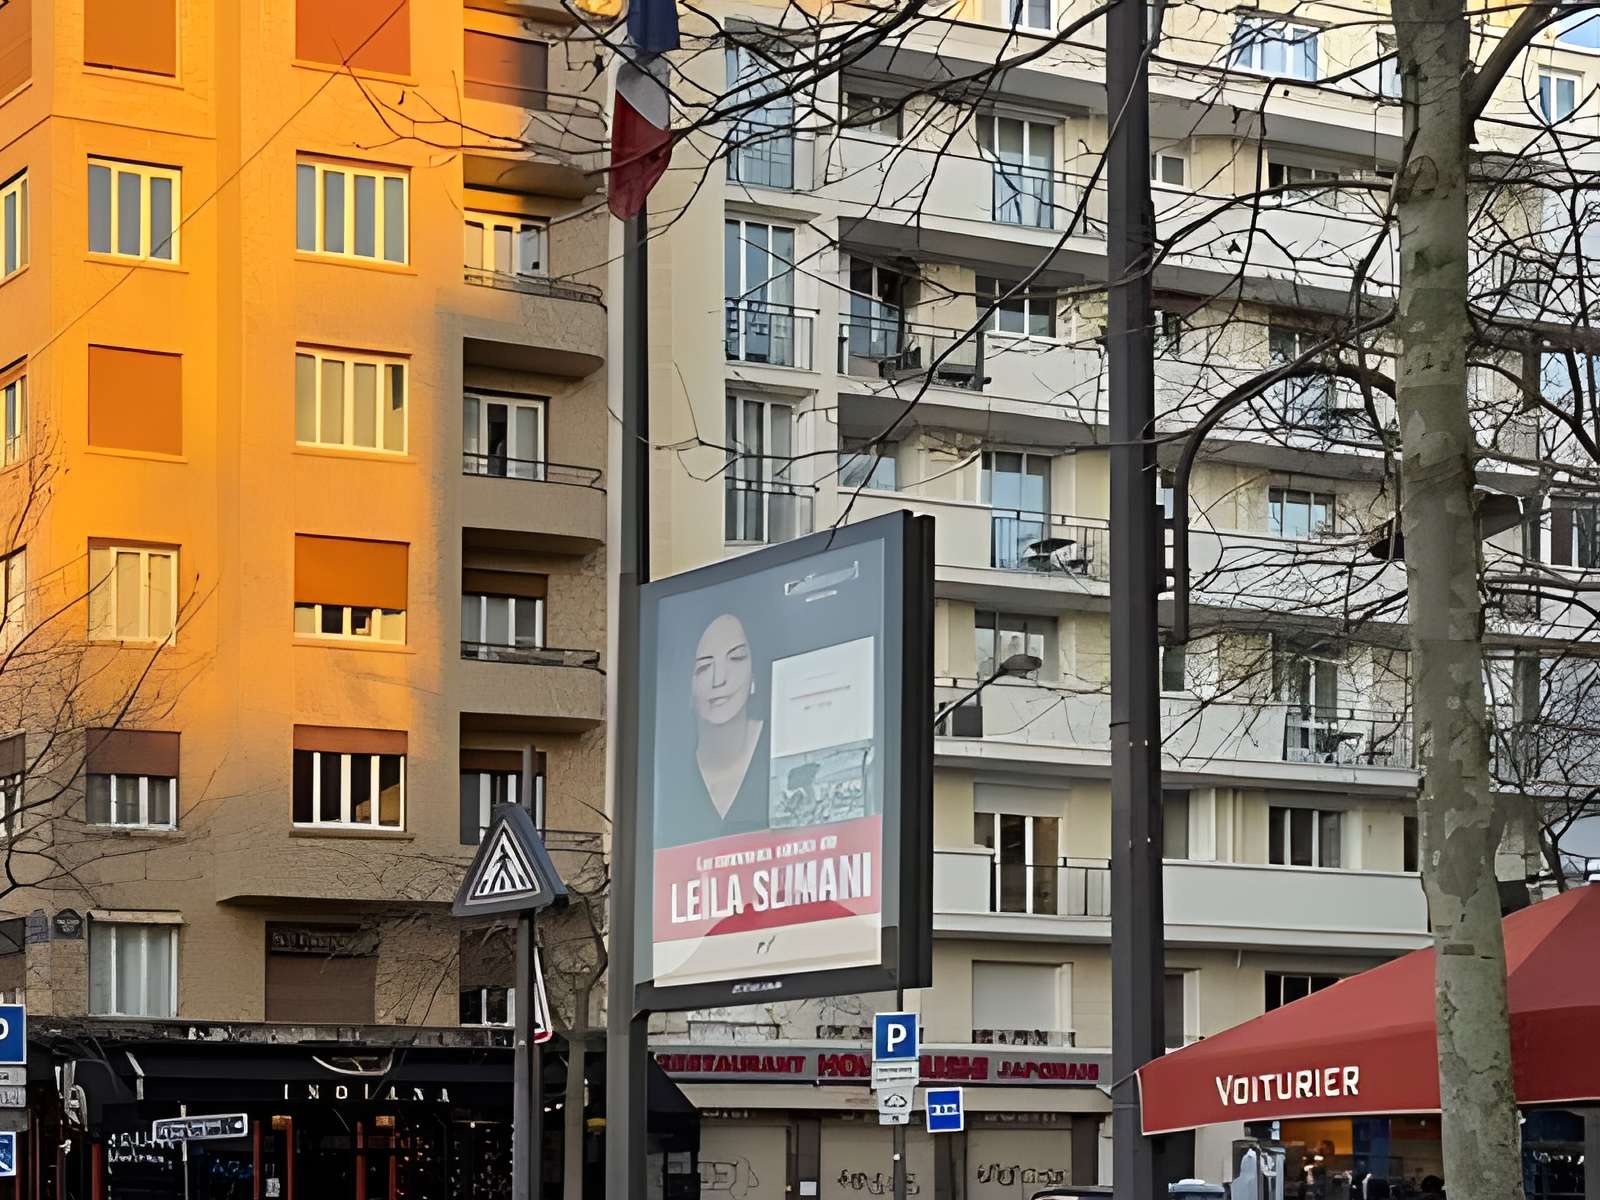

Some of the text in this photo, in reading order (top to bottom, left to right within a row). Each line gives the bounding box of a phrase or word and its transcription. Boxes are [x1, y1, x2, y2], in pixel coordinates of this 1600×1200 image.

[887, 1023, 907, 1052] P
[284, 1083, 450, 1103] INDIANA
[1215, 1066, 1359, 1106] VOITURIER
